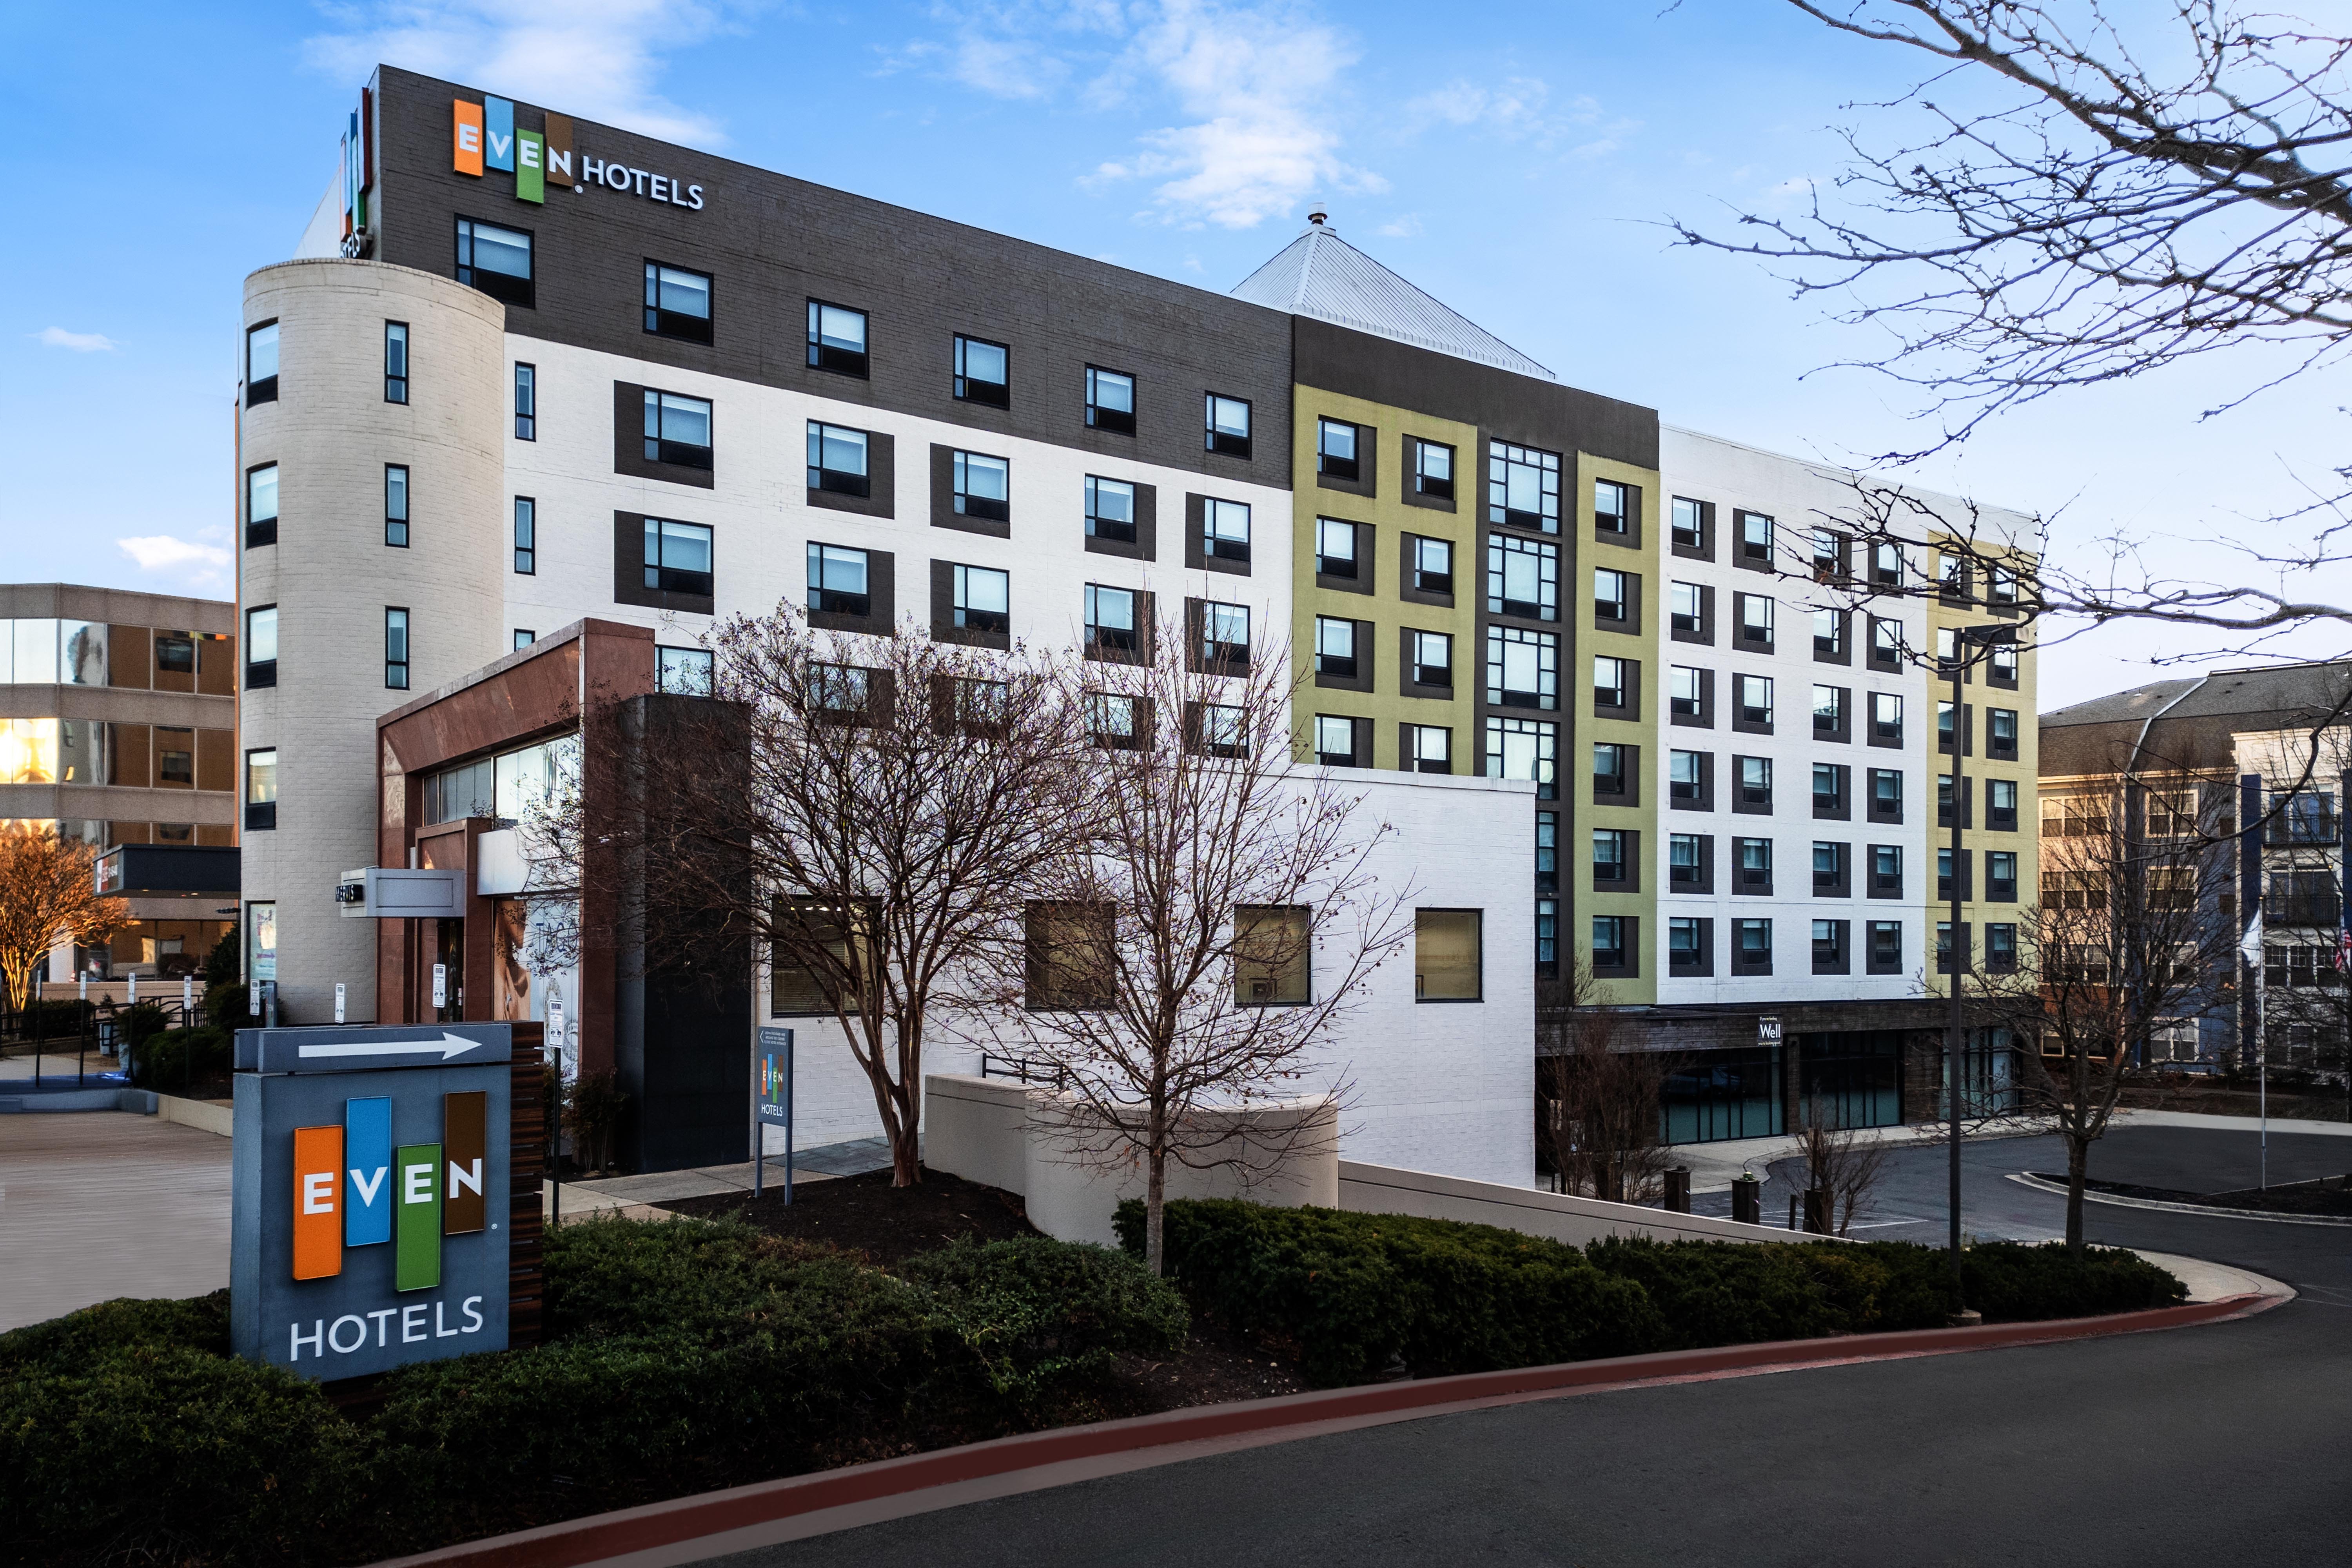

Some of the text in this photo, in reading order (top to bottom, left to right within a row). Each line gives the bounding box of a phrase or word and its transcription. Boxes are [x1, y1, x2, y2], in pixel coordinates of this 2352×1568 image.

[459, 123, 704, 210] EVEN HOTELS
[1760, 1024, 1780, 1038] Well
[762, 1070, 783, 1083] EVEN
[761, 1103, 783, 1117] HOTELS
[303, 1158, 482, 1215] EVEN
[290, 1295, 484, 1362] HOTELS
